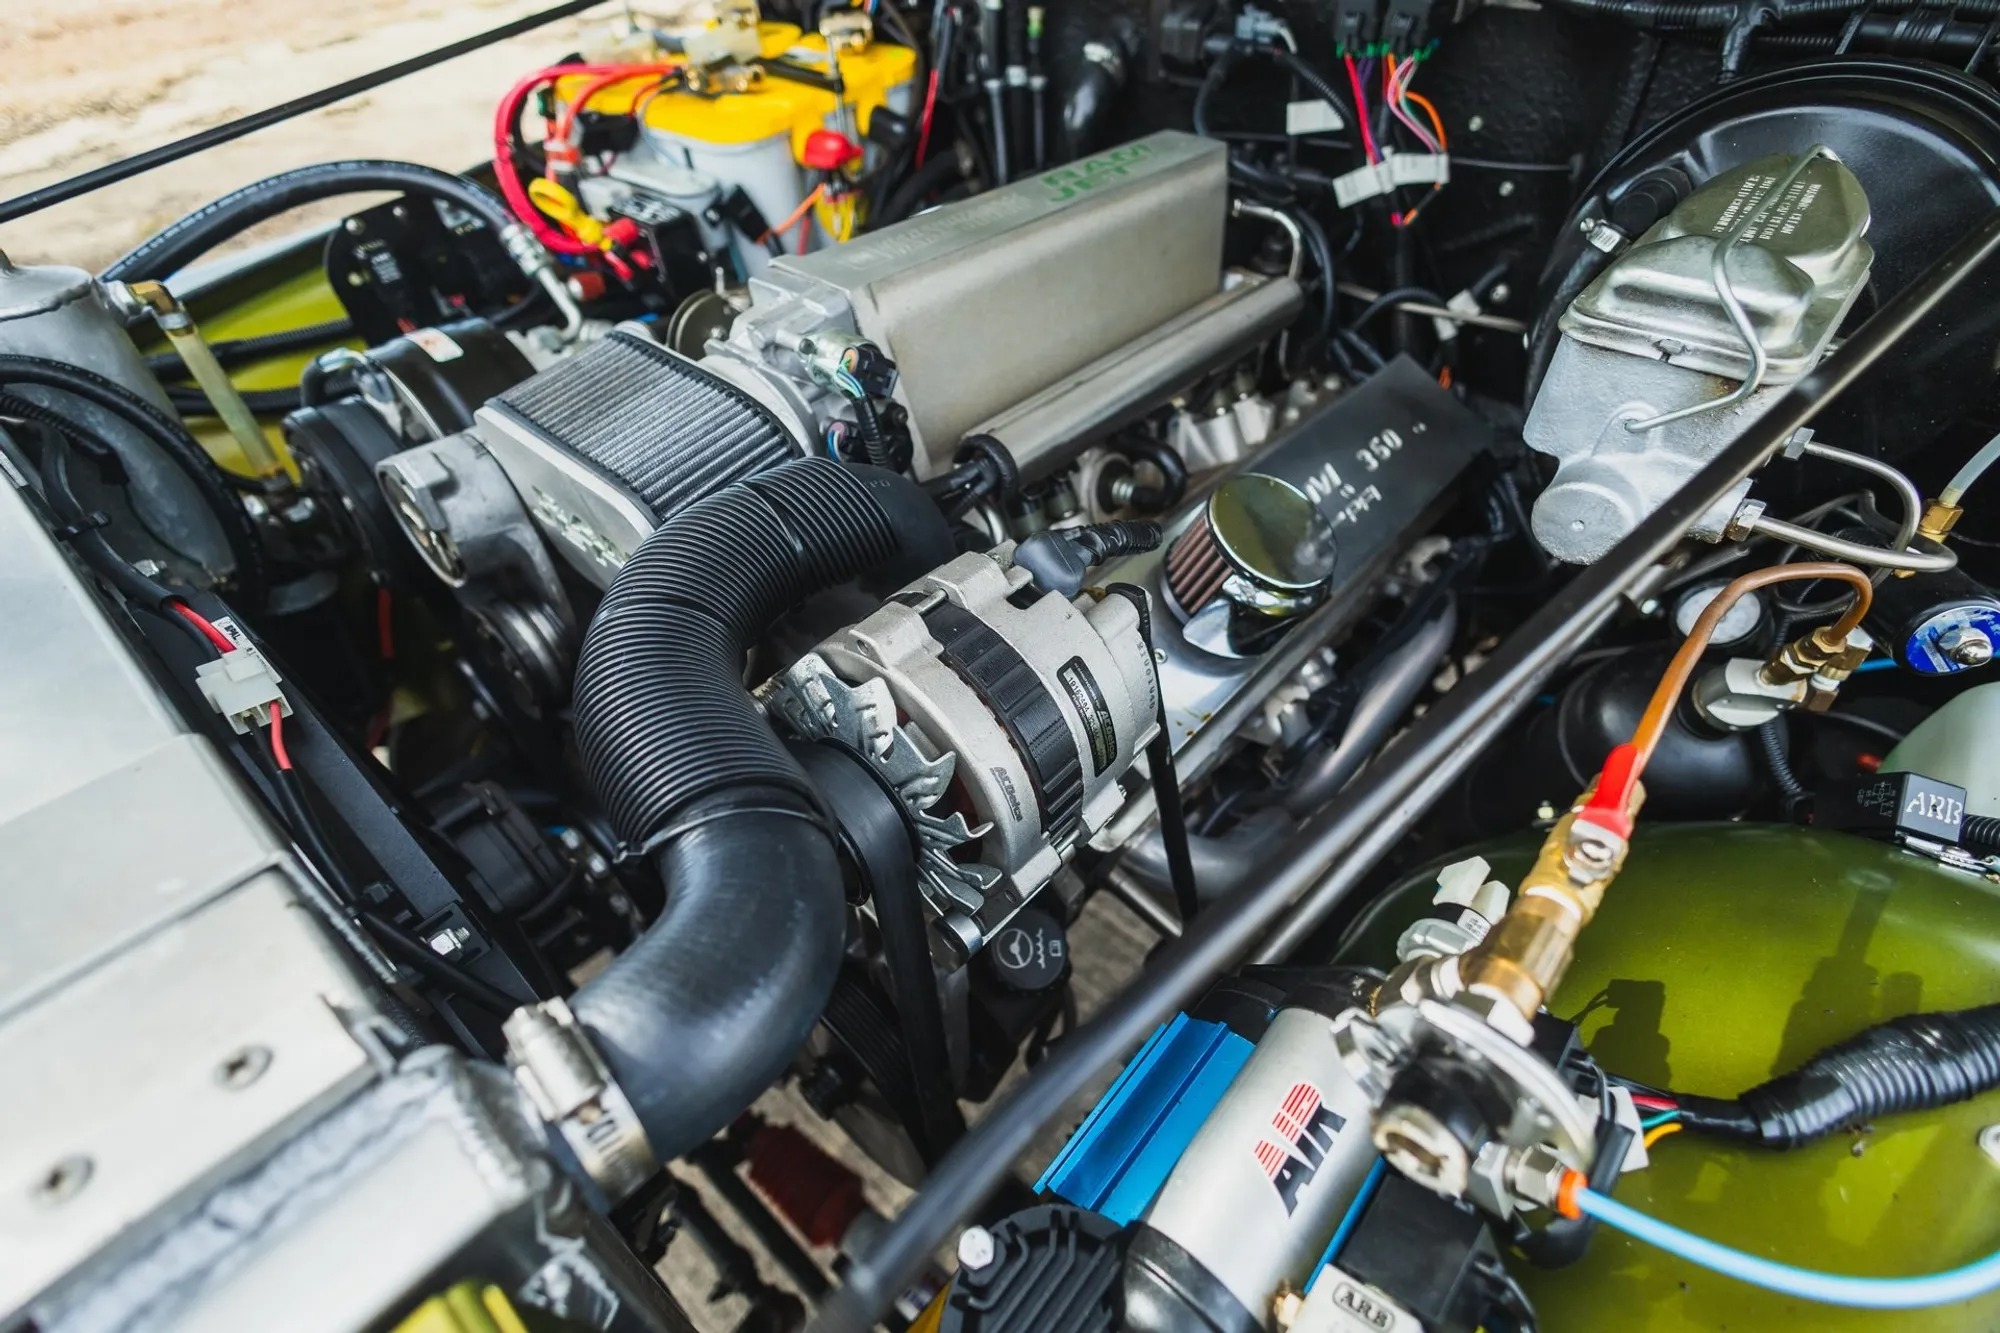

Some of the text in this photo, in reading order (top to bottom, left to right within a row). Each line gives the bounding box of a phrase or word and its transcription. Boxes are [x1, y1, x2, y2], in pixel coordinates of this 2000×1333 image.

[1042, 145, 1151, 186] RAM
[1048, 165, 1129, 201] JET
[1355, 428, 1404, 471] 350
[994, 767, 1023, 822] ACDelco
[1906, 792, 1962, 824] ARB
[1254, 1083, 1347, 1218] AIR
[1340, 1291, 1388, 1327] ARB
